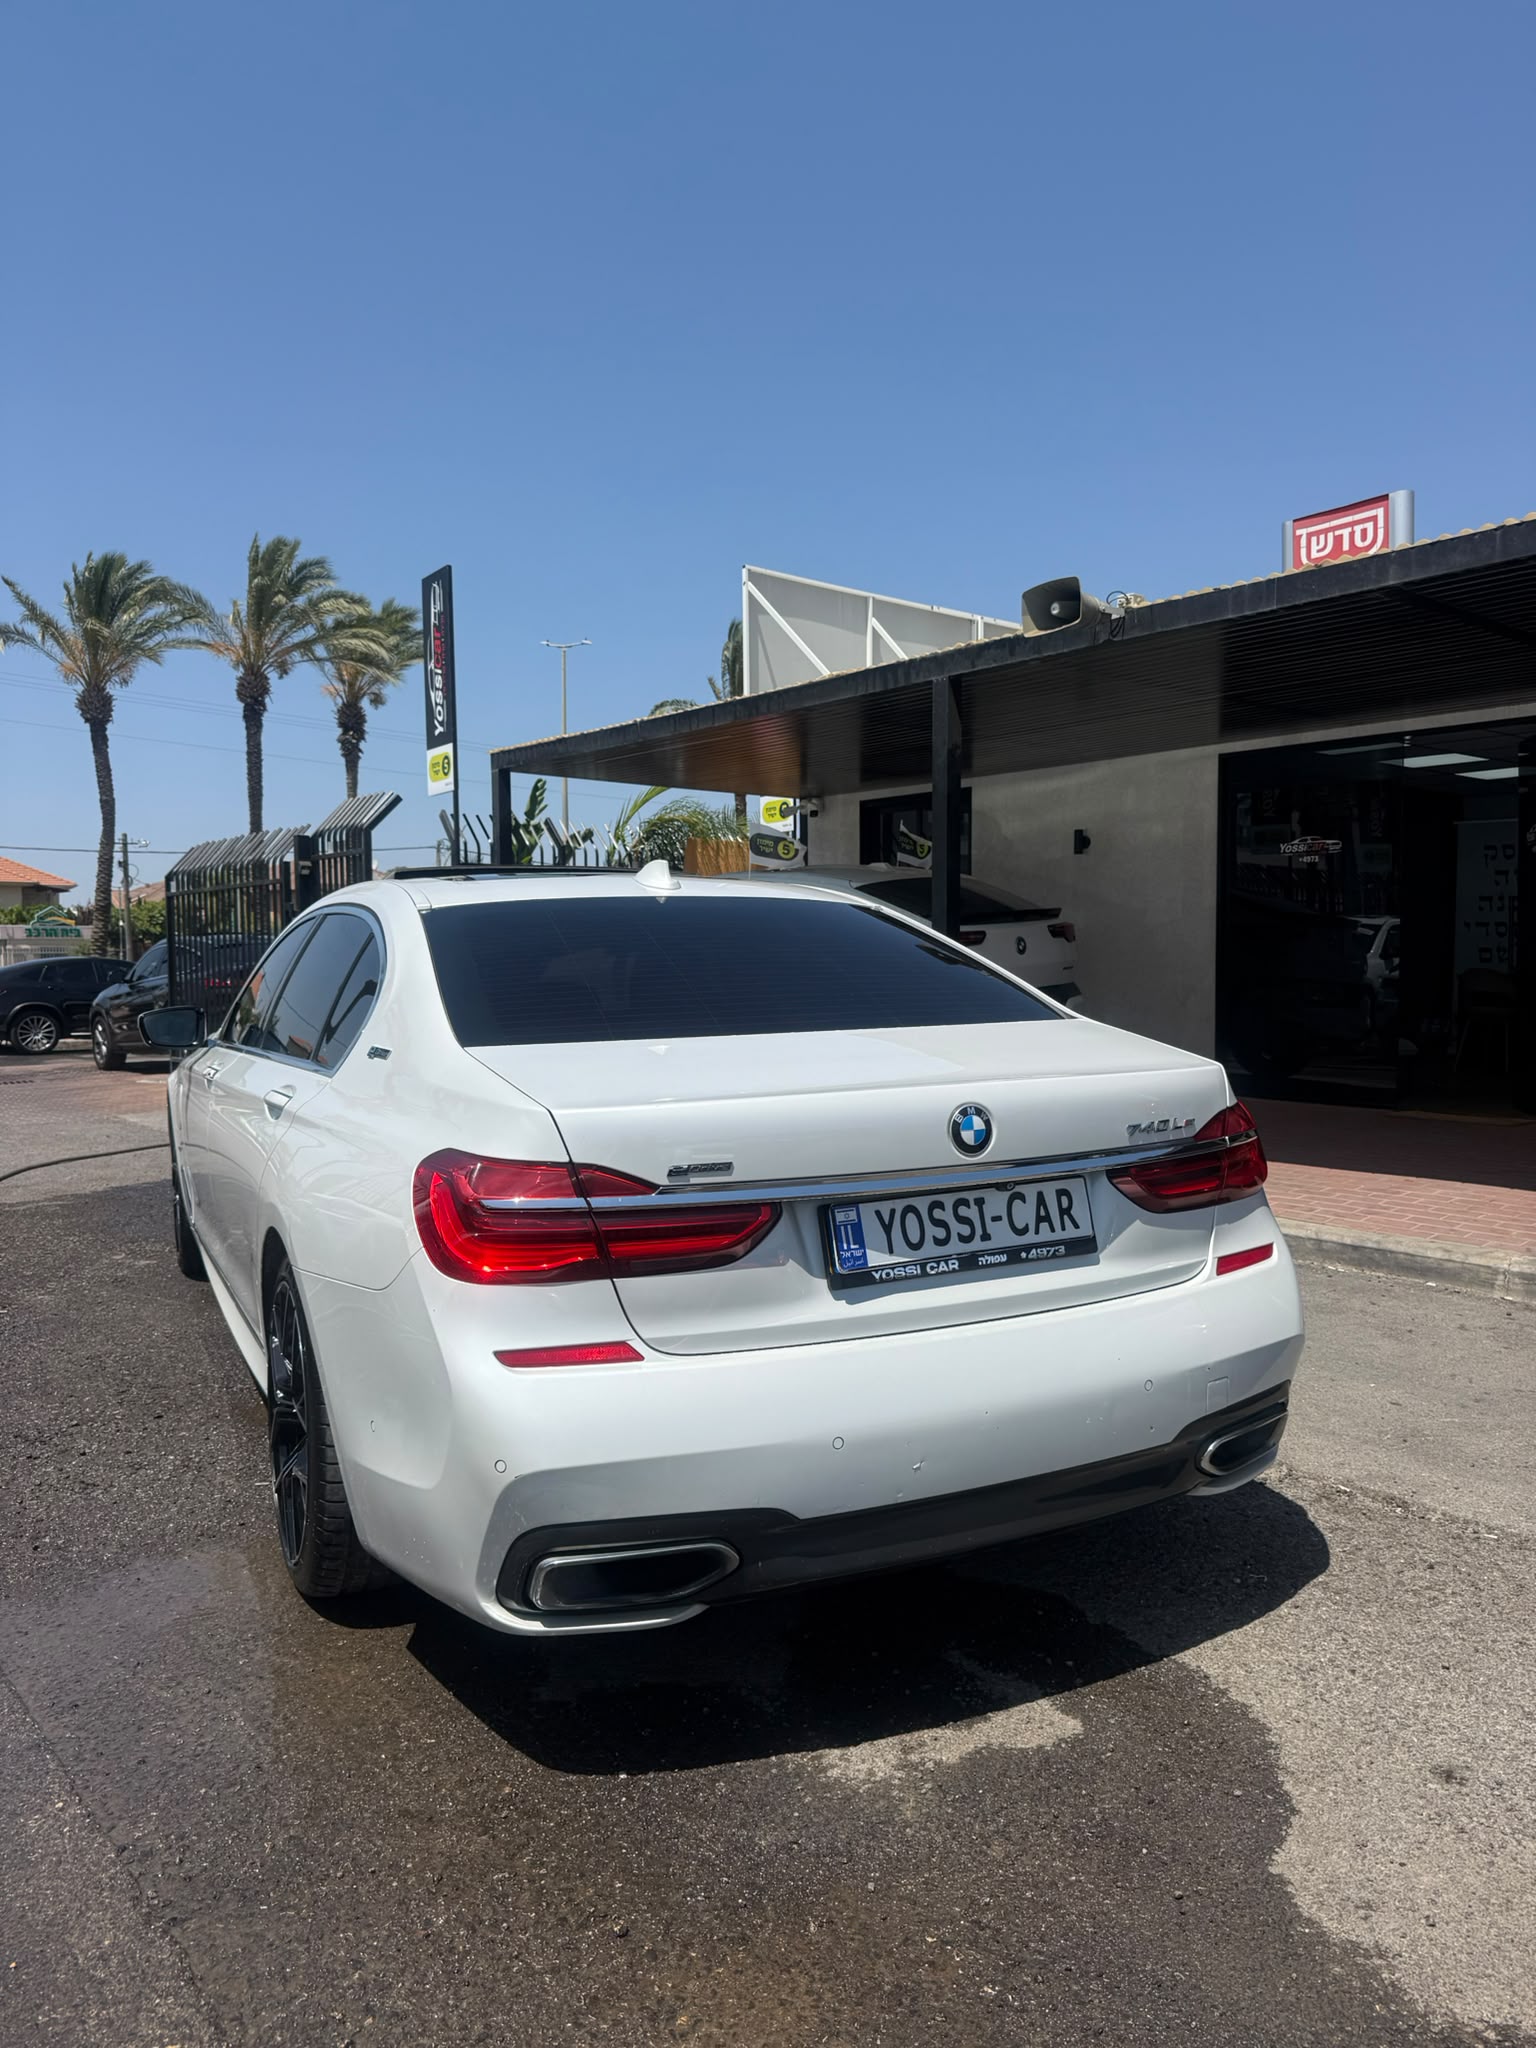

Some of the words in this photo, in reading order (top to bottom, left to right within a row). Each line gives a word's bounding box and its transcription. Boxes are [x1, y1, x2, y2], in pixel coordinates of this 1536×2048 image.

[434, 625, 444, 737] Yossicar
[756, 837, 775, 847] מימון
[1279, 842, 1324, 854] Yossicar
[955, 1106, 989, 1124] BMW
[874, 1188, 1081, 1255] YOSSI-CAR
[840, 1224, 860, 1250] IL
[840, 1248, 865, 1258] ישראל
[872, 1264, 921, 1281] YOSSI
[926, 1259, 960, 1275] CAR
[978, 1253, 1008, 1266] עפולה
